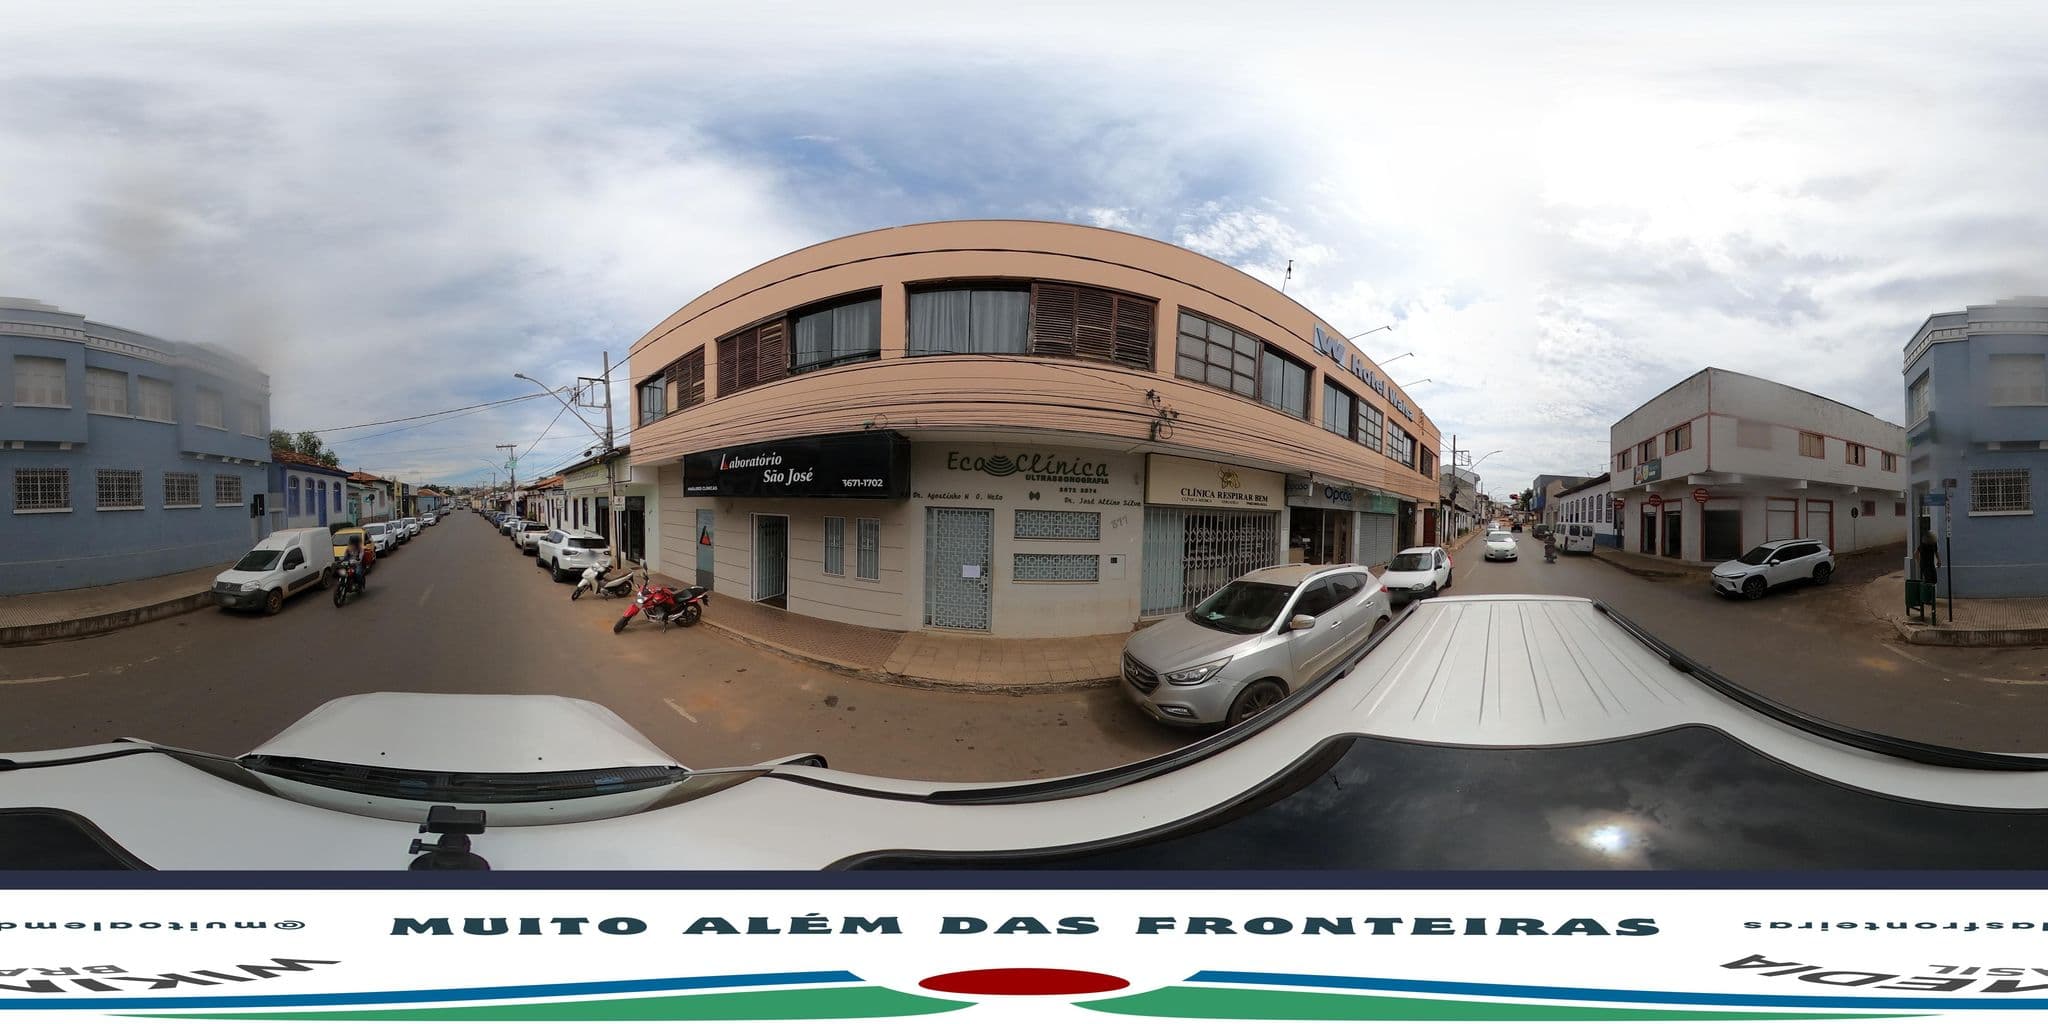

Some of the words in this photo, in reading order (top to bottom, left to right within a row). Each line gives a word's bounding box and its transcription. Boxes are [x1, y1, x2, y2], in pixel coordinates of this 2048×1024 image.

[1351, 354, 1384, 397] Hotel
[719, 451, 782, 470] Laboratório
[947, 451, 986, 471] Eco
[1015, 452, 1110, 477] Clínica
[763, 468, 784, 483] São
[785, 467, 813, 486] José
[1025, 474, 1110, 484] ULTRASSONOGRAFIA
[1180, 487, 1215, 499] CLÍNICA
[1217, 491, 1253, 502] RESPIRAR
[1254, 494, 1268, 503] BEM
